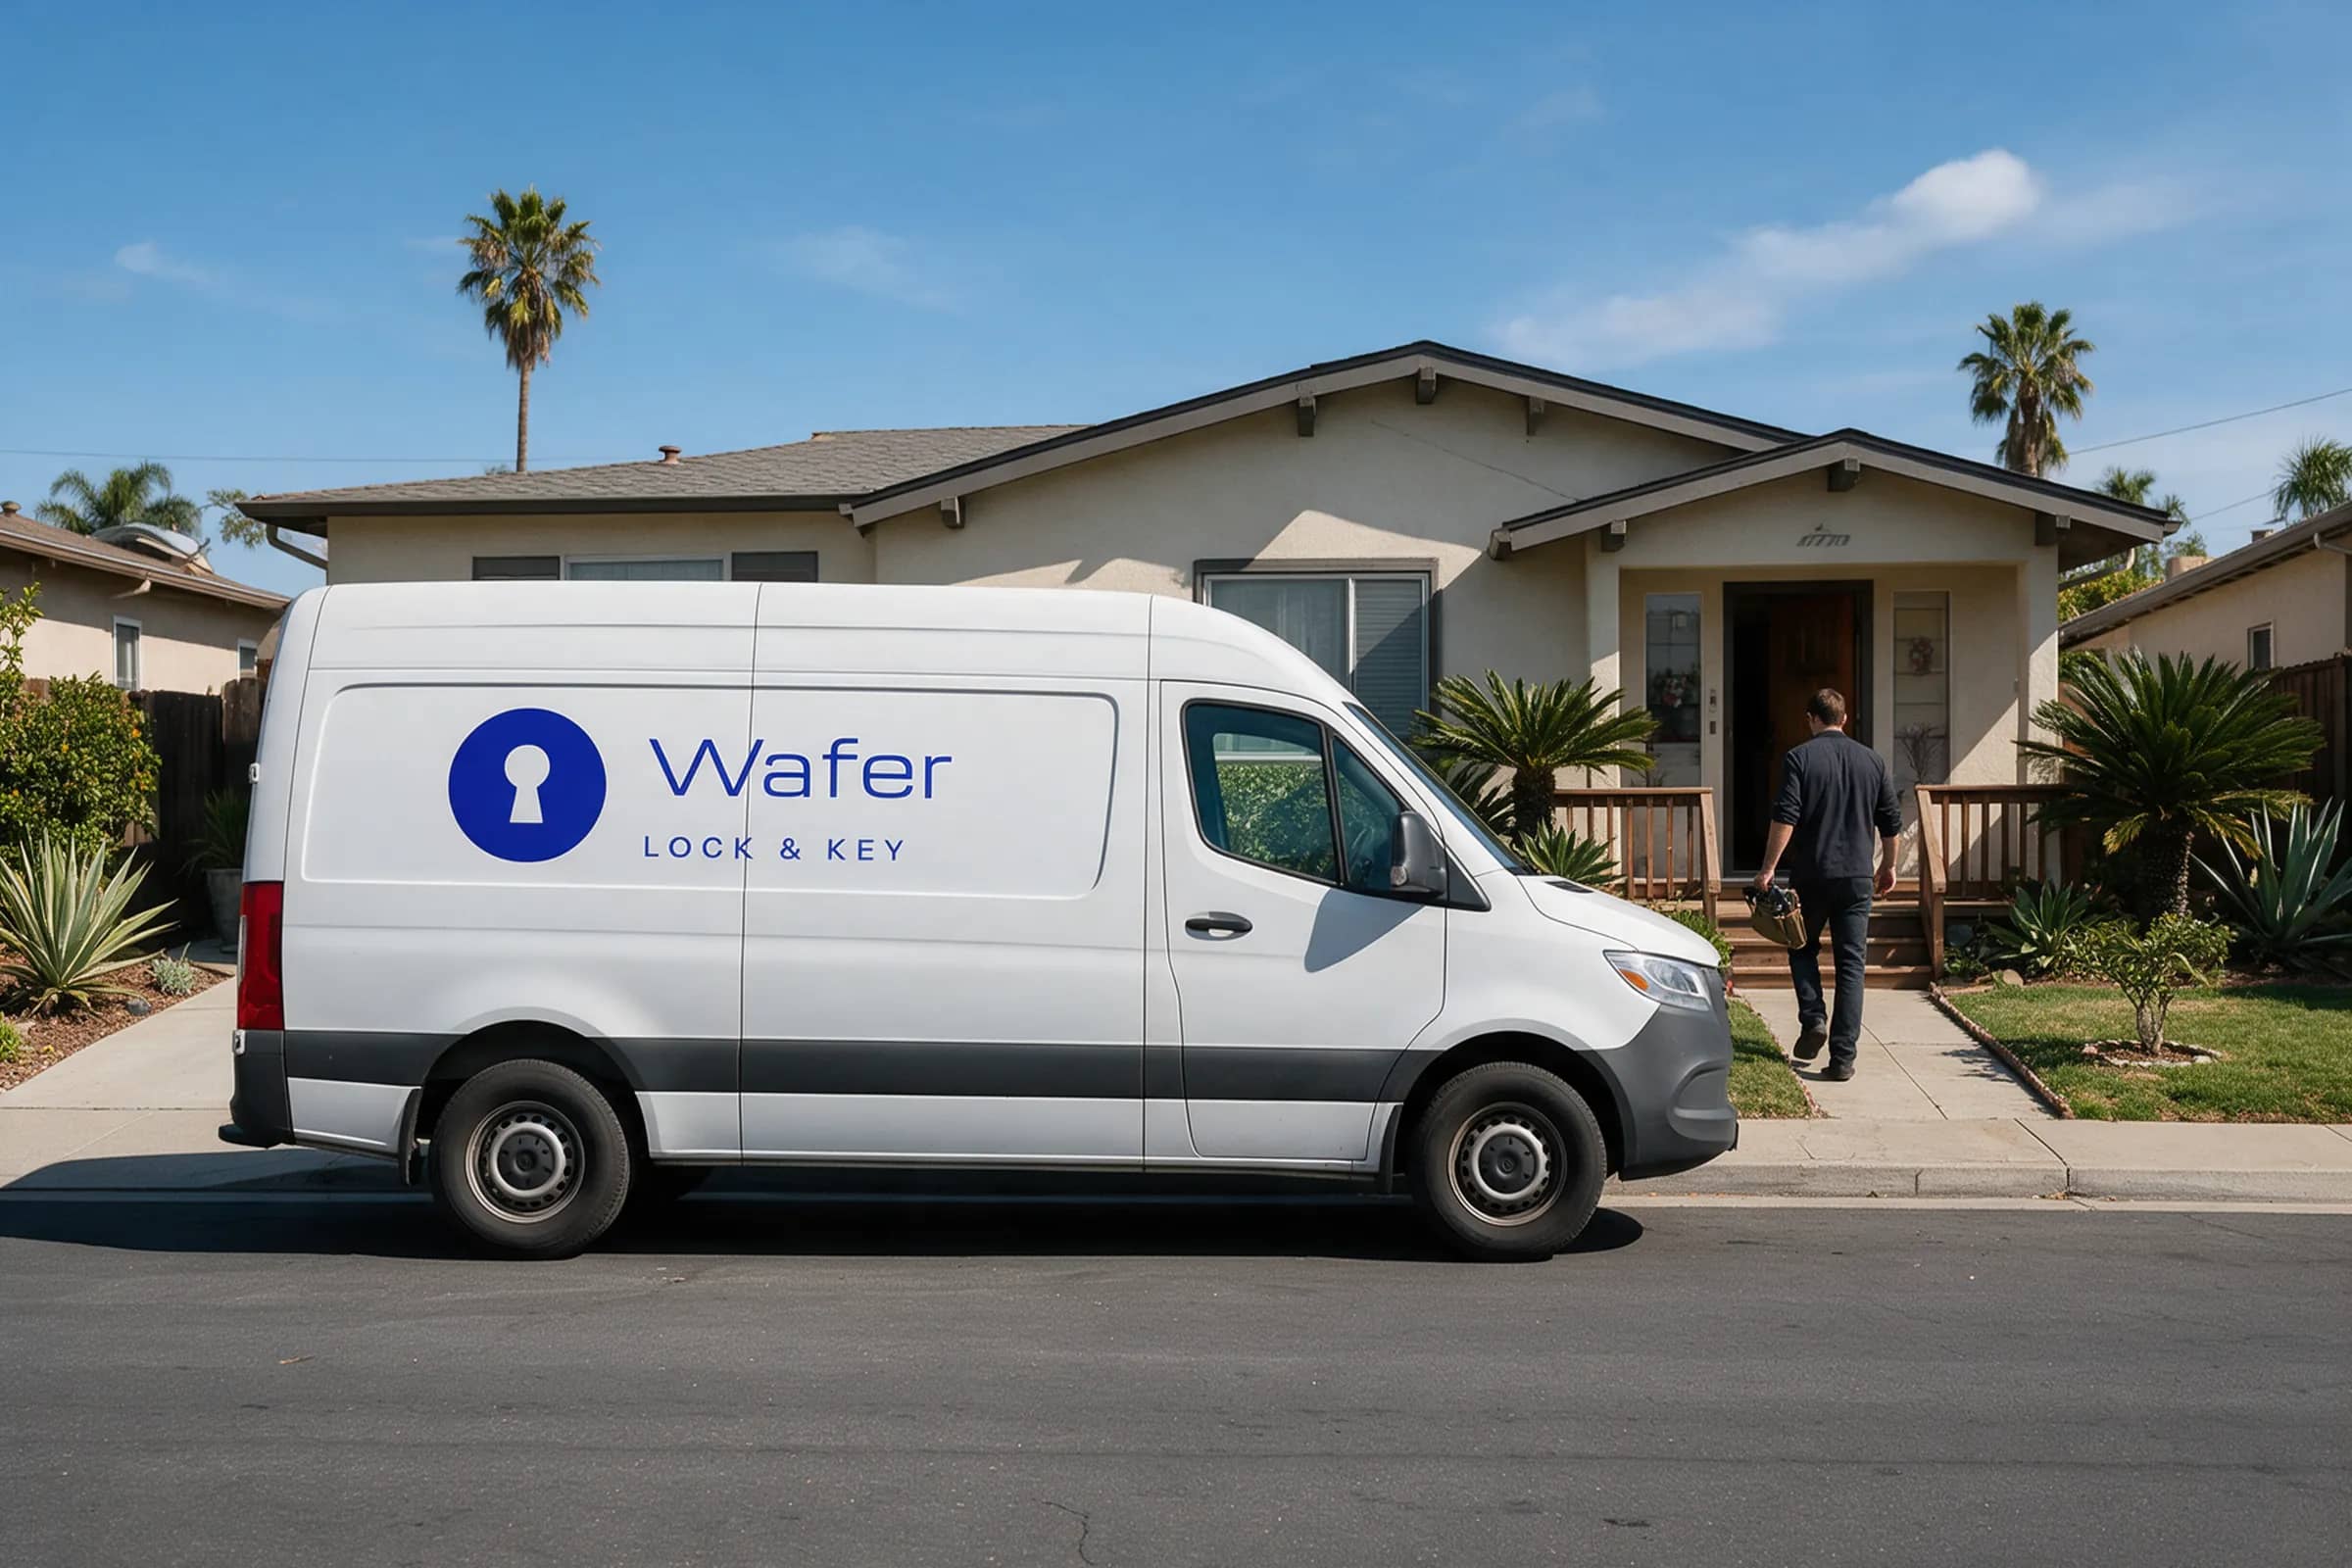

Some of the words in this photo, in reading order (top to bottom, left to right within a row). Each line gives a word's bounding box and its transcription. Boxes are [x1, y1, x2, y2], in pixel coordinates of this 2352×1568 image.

[649, 737, 953, 799] Wafer
[644, 836, 753, 859] LOCK
[779, 838, 801, 859] &
[827, 839, 904, 861] KEY
